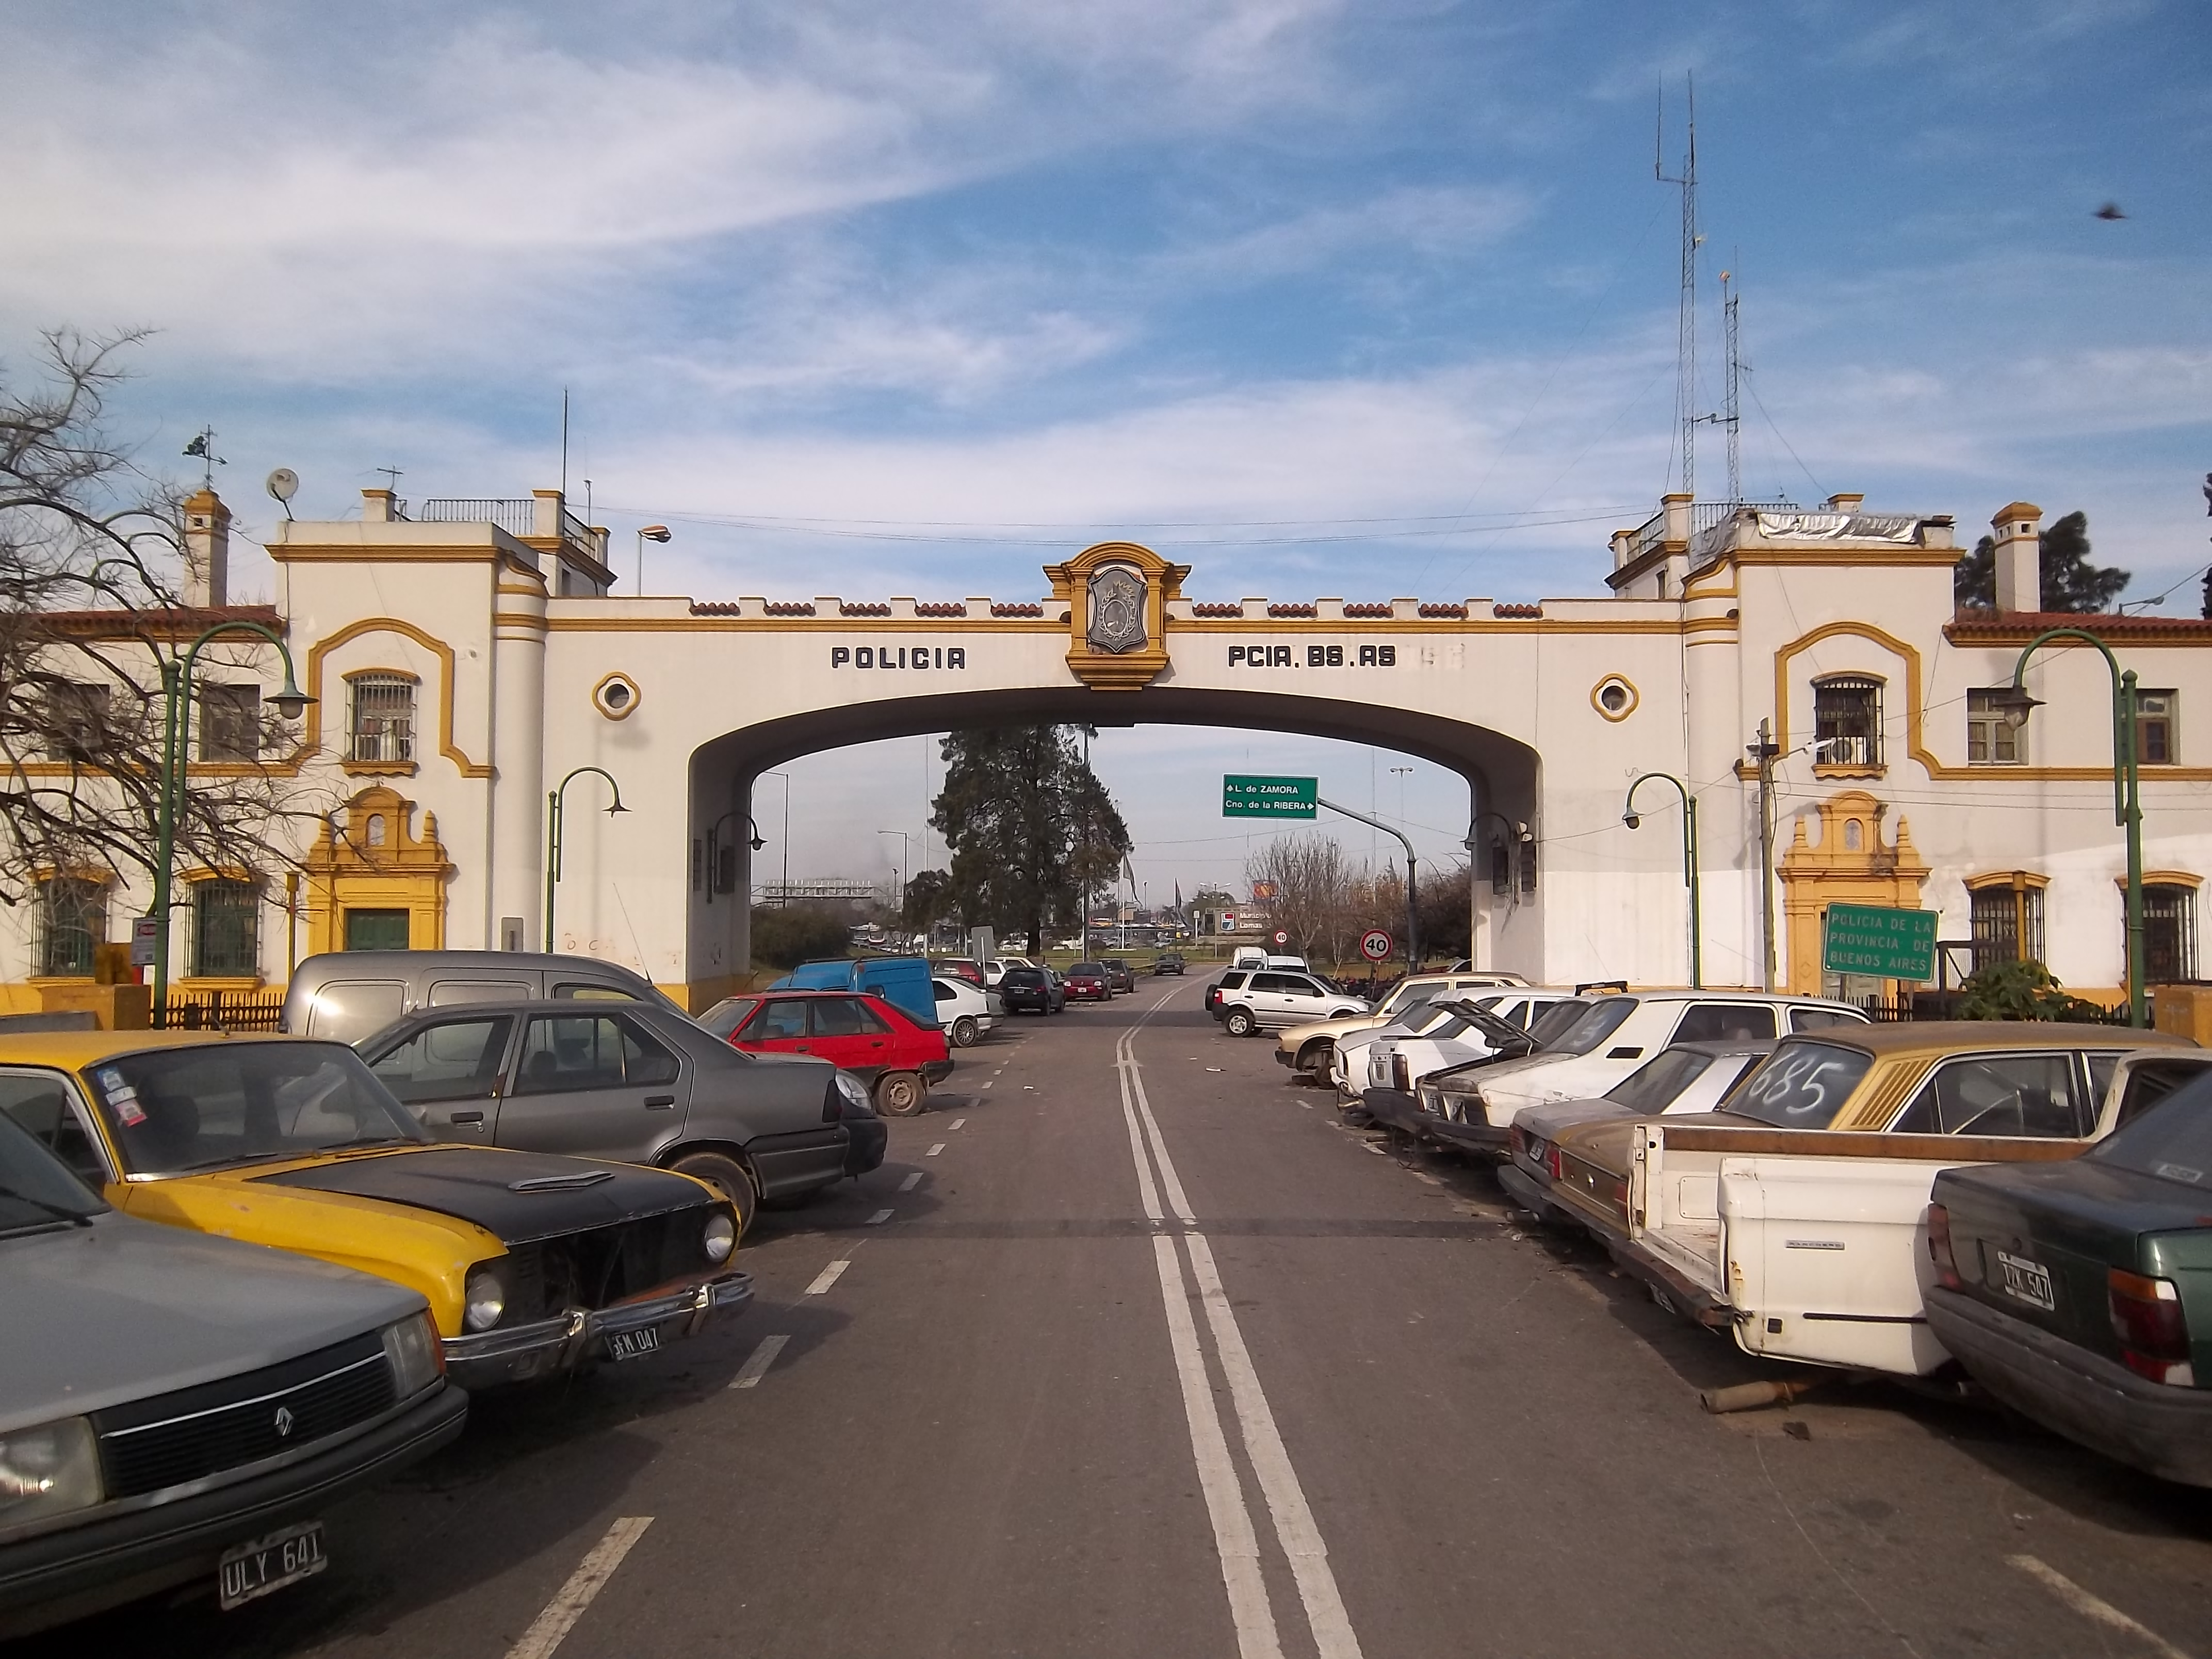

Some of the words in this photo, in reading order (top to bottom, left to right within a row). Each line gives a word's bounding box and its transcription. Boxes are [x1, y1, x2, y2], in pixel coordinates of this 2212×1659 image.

[831, 646, 966, 670] POLICIA
[1260, 786, 1299, 794] ZAMORA
[1248, 801, 1260, 809] de
[1274, 801, 1306, 810] RIBERA
[1831, 913, 1882, 928] POLICIA
[1891, 918, 1906, 931] DE
[1915, 920, 1931, 933] LA
[1365, 938, 1387, 952] 40
[1830, 932, 1898, 949] PROVINCIA
[1914, 940, 1930, 952] DE
[1830, 952, 1880, 967] BUENOS
[1889, 958, 1926, 972] AIRES
[1748, 1050, 1845, 1114] 685
[2027, 1272, 2048, 1299] 547
[635, 1327, 658, 1350] 047
[225, 1550, 267, 1597] ULY
[283, 1532, 323, 1573] 641
